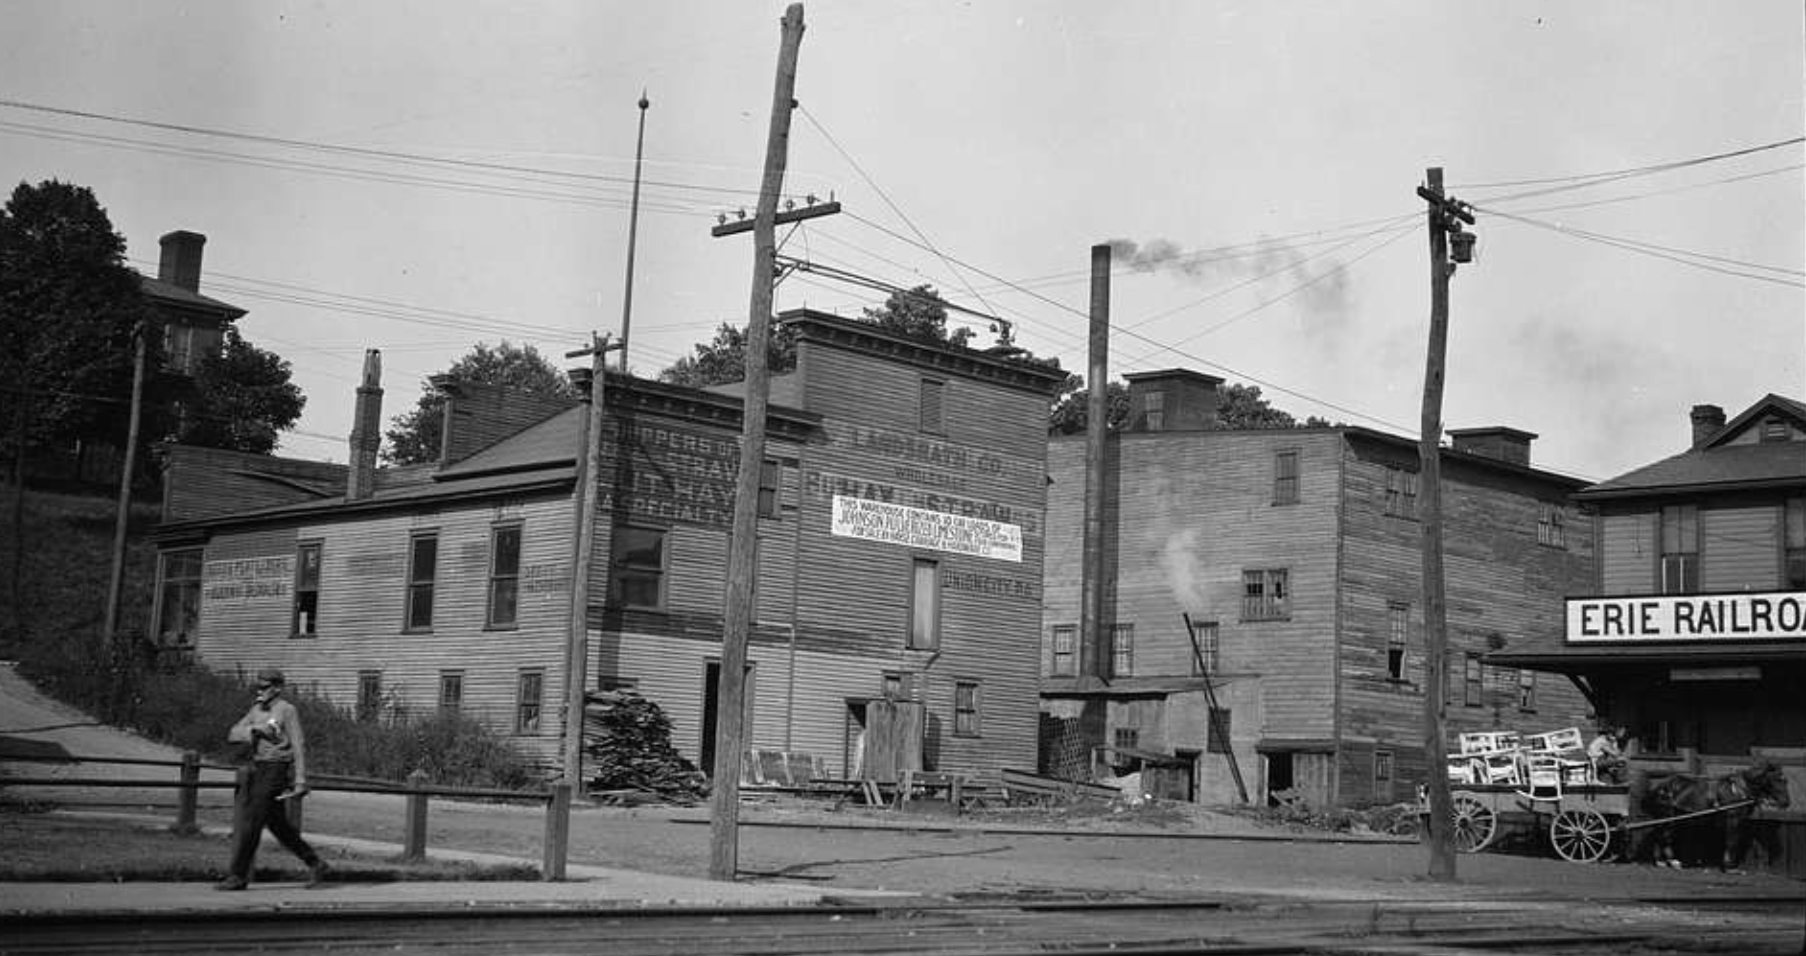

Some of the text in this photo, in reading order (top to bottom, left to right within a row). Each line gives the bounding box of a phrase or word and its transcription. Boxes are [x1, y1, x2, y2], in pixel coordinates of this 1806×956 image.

[838, 508, 883, 528] JOHNSON
[1581, 597, 1806, 636] ERIE RAILRO
